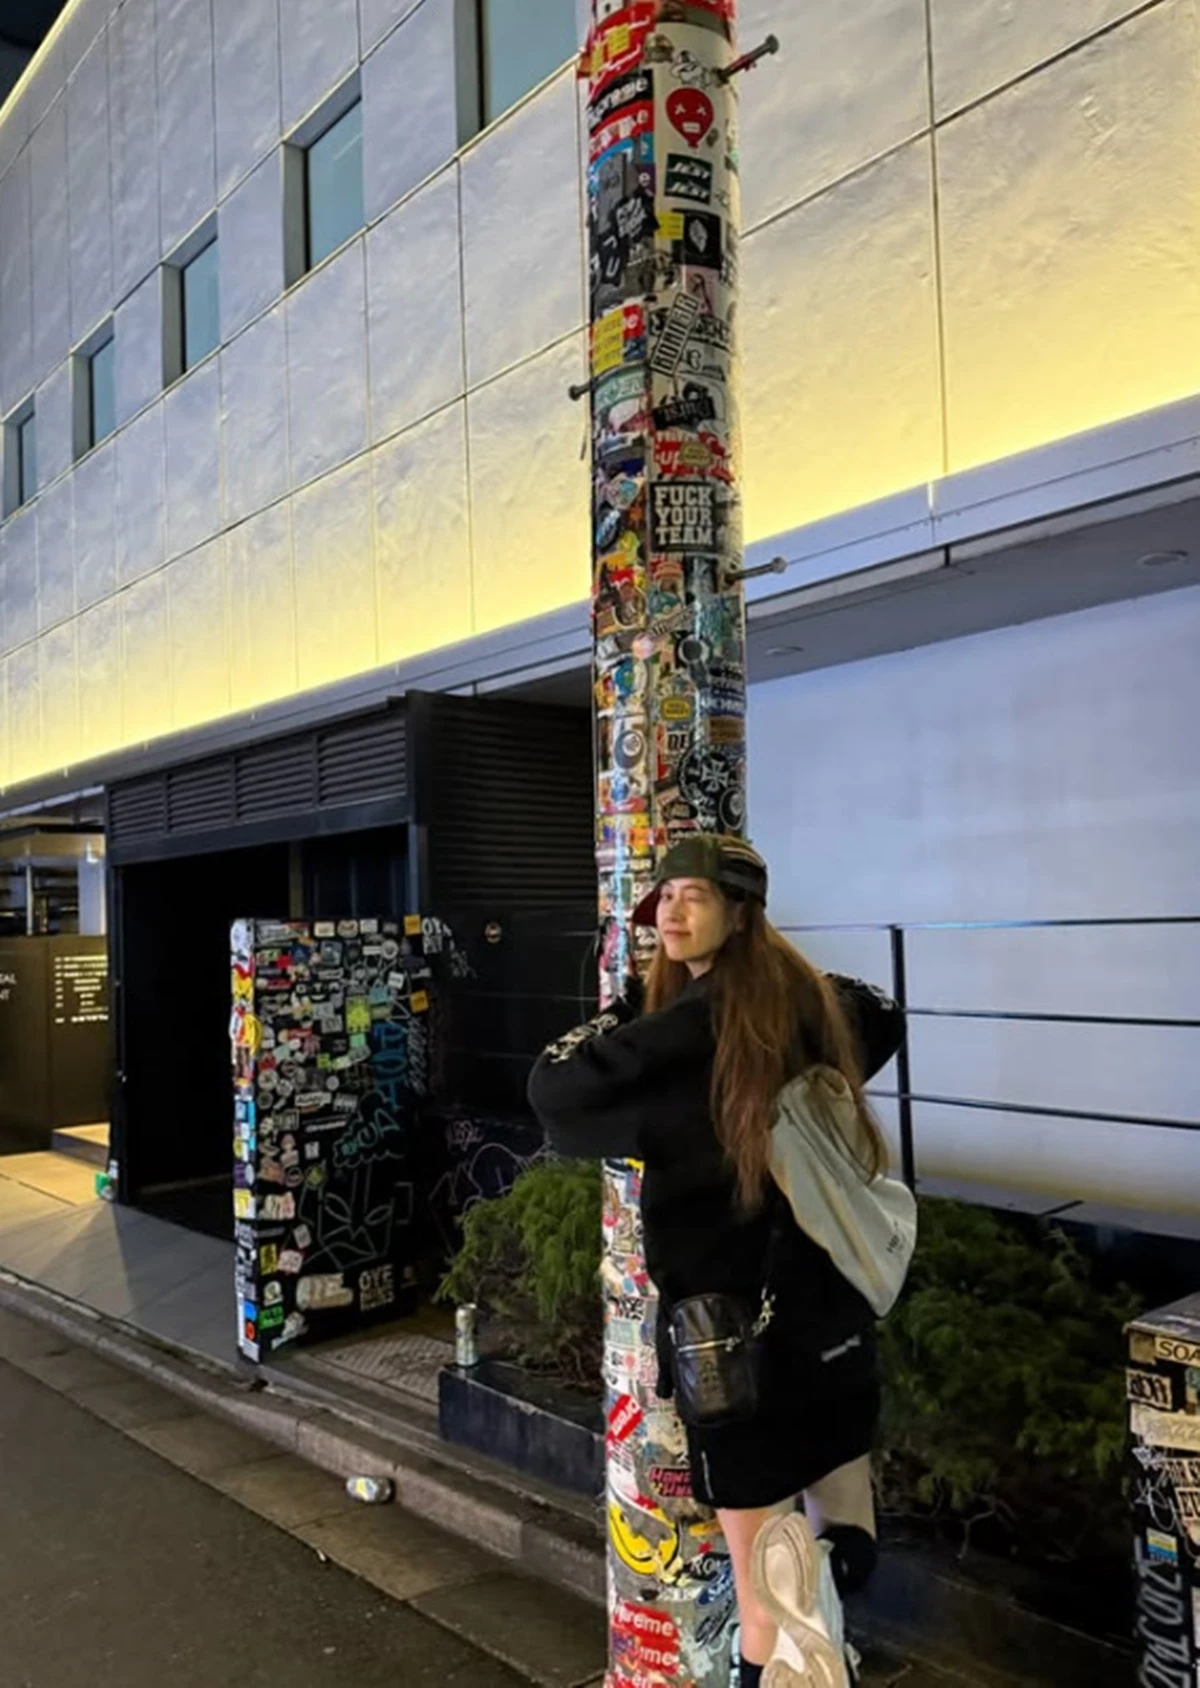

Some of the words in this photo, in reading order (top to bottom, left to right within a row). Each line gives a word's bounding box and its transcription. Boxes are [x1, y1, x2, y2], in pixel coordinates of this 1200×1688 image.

[654, 486, 713, 506] FUCK
[656, 507, 713, 526] YOUR
[656, 527, 713, 545] TEAM
